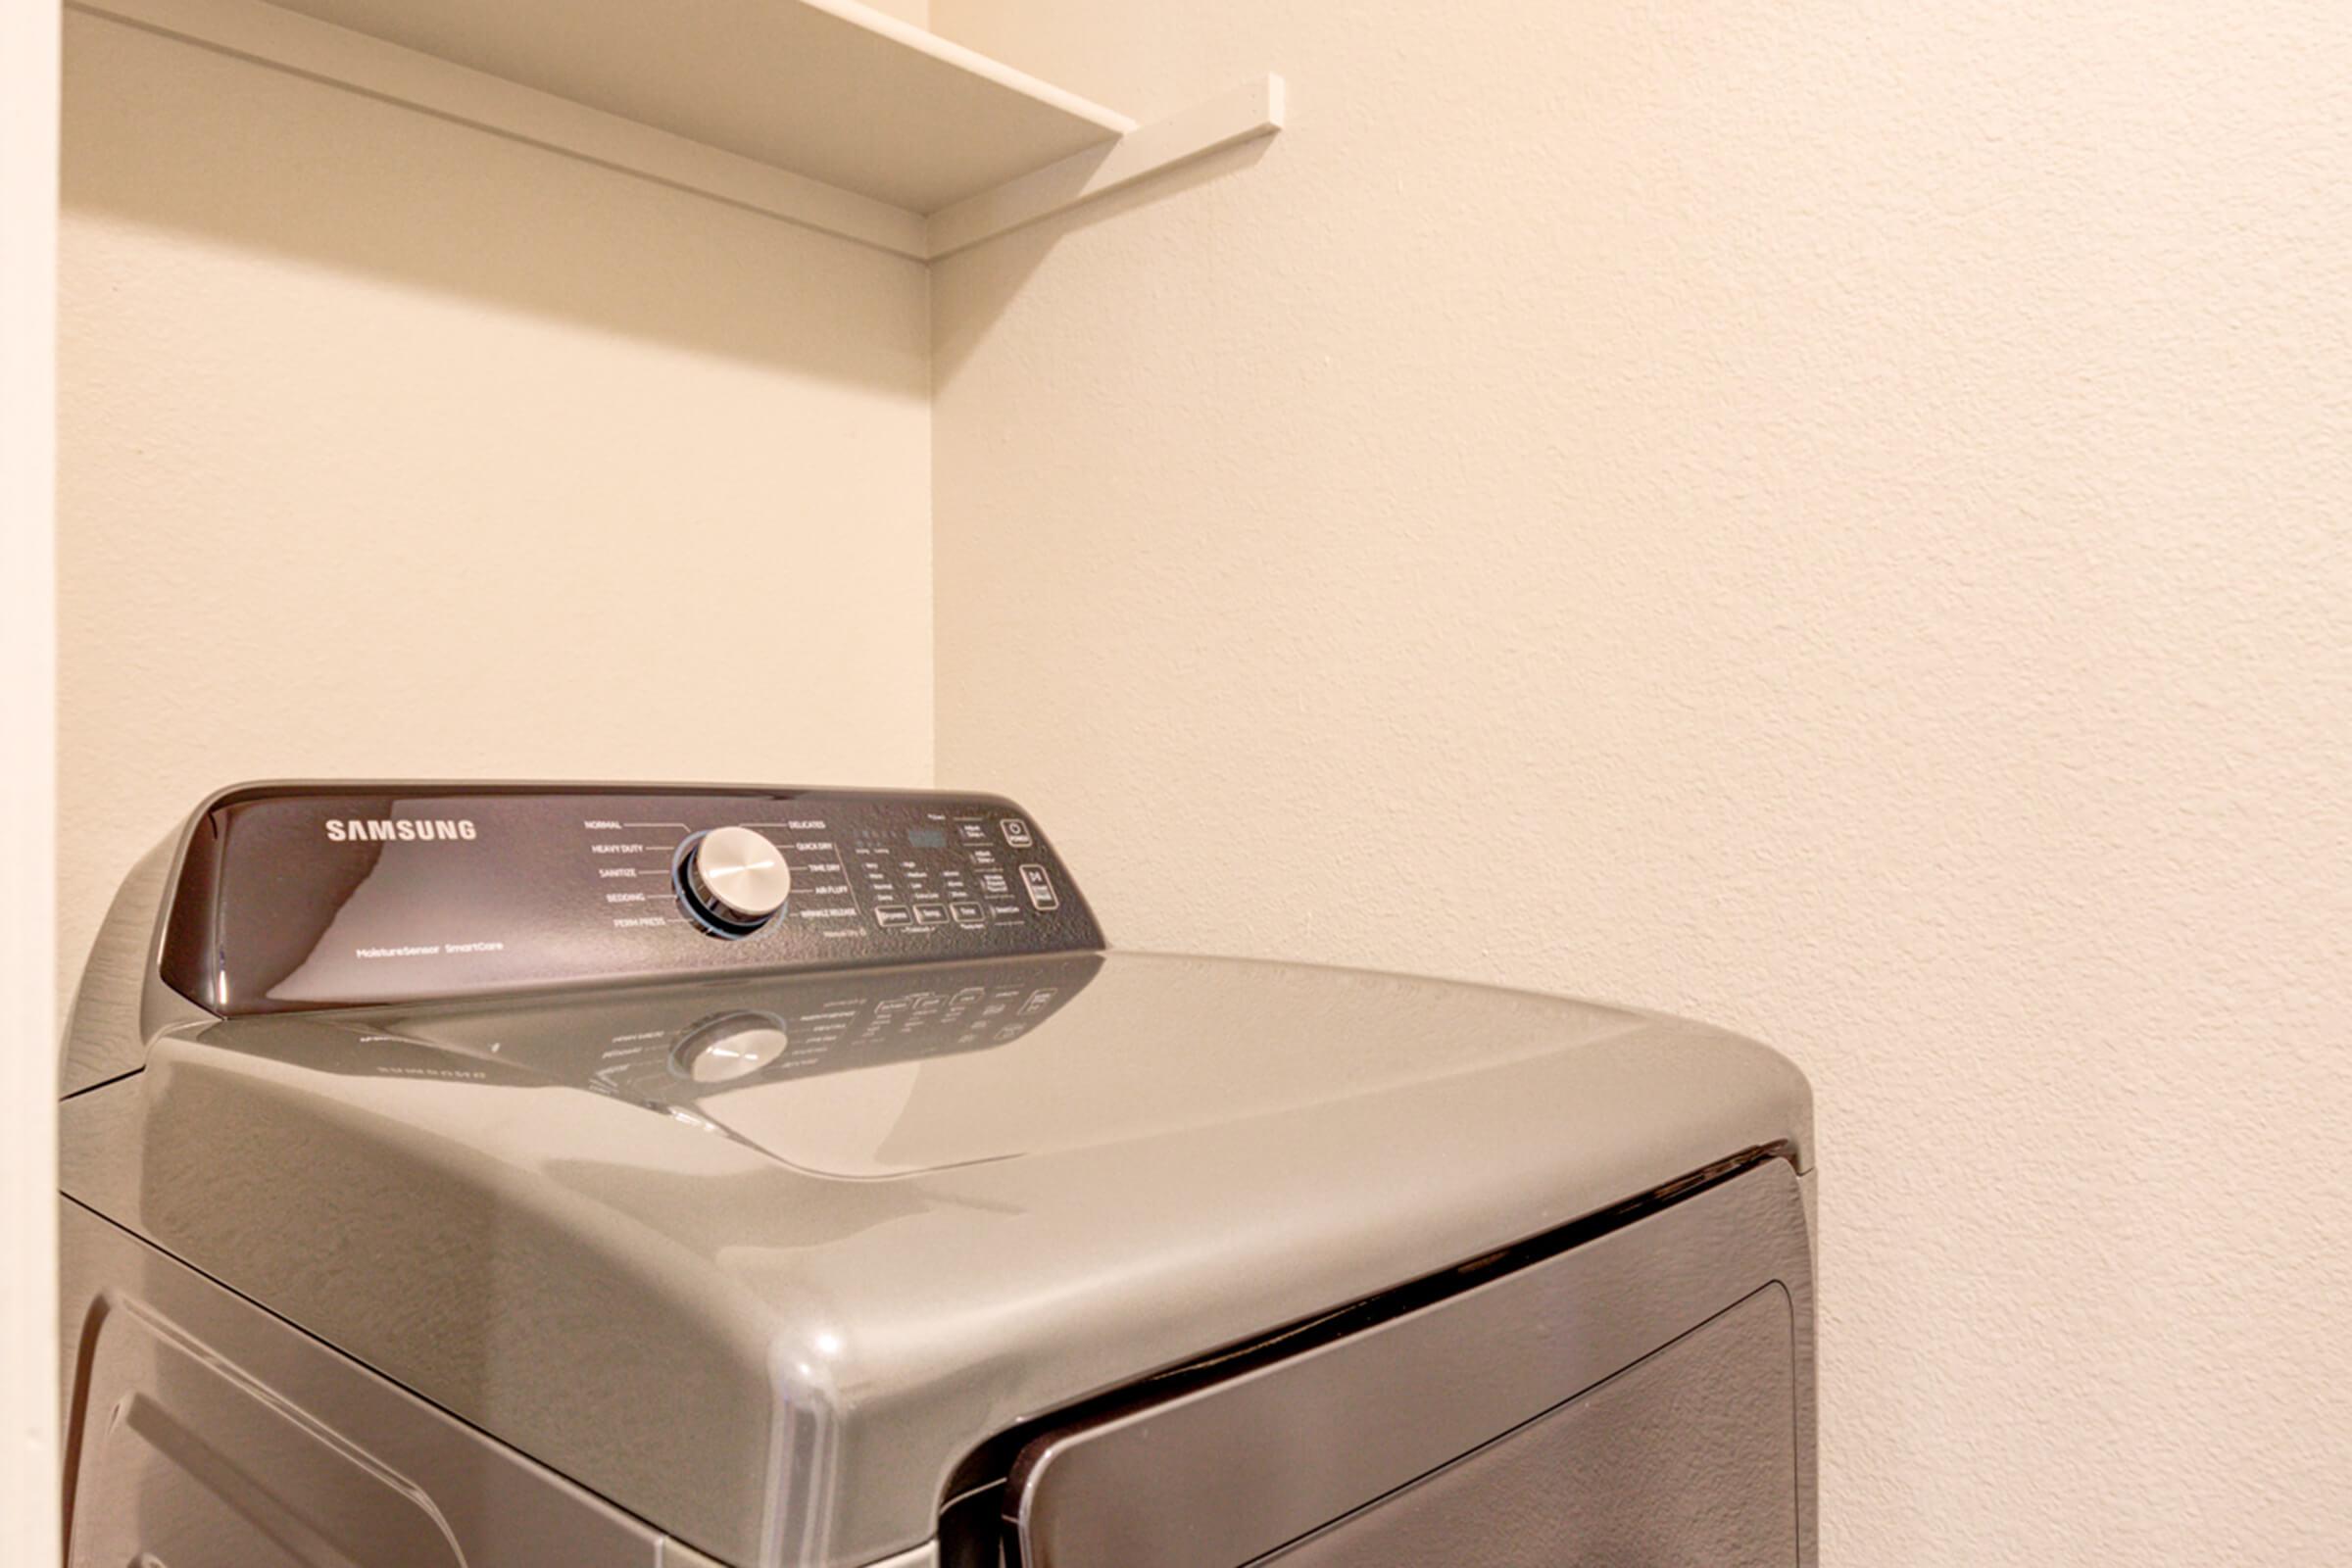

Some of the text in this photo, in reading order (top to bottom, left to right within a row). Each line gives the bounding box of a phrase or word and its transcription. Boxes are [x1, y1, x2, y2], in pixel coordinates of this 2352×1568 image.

[584, 821, 622, 830] NORMAL
[788, 820, 826, 829] DELICATES
[325, 819, 477, 841] SAMSUNG
[591, 845, 619, 854] HEAVY
[599, 868, 637, 878] SANITIZE
[356, 942, 504, 958] MoistureSensor SmartCare
